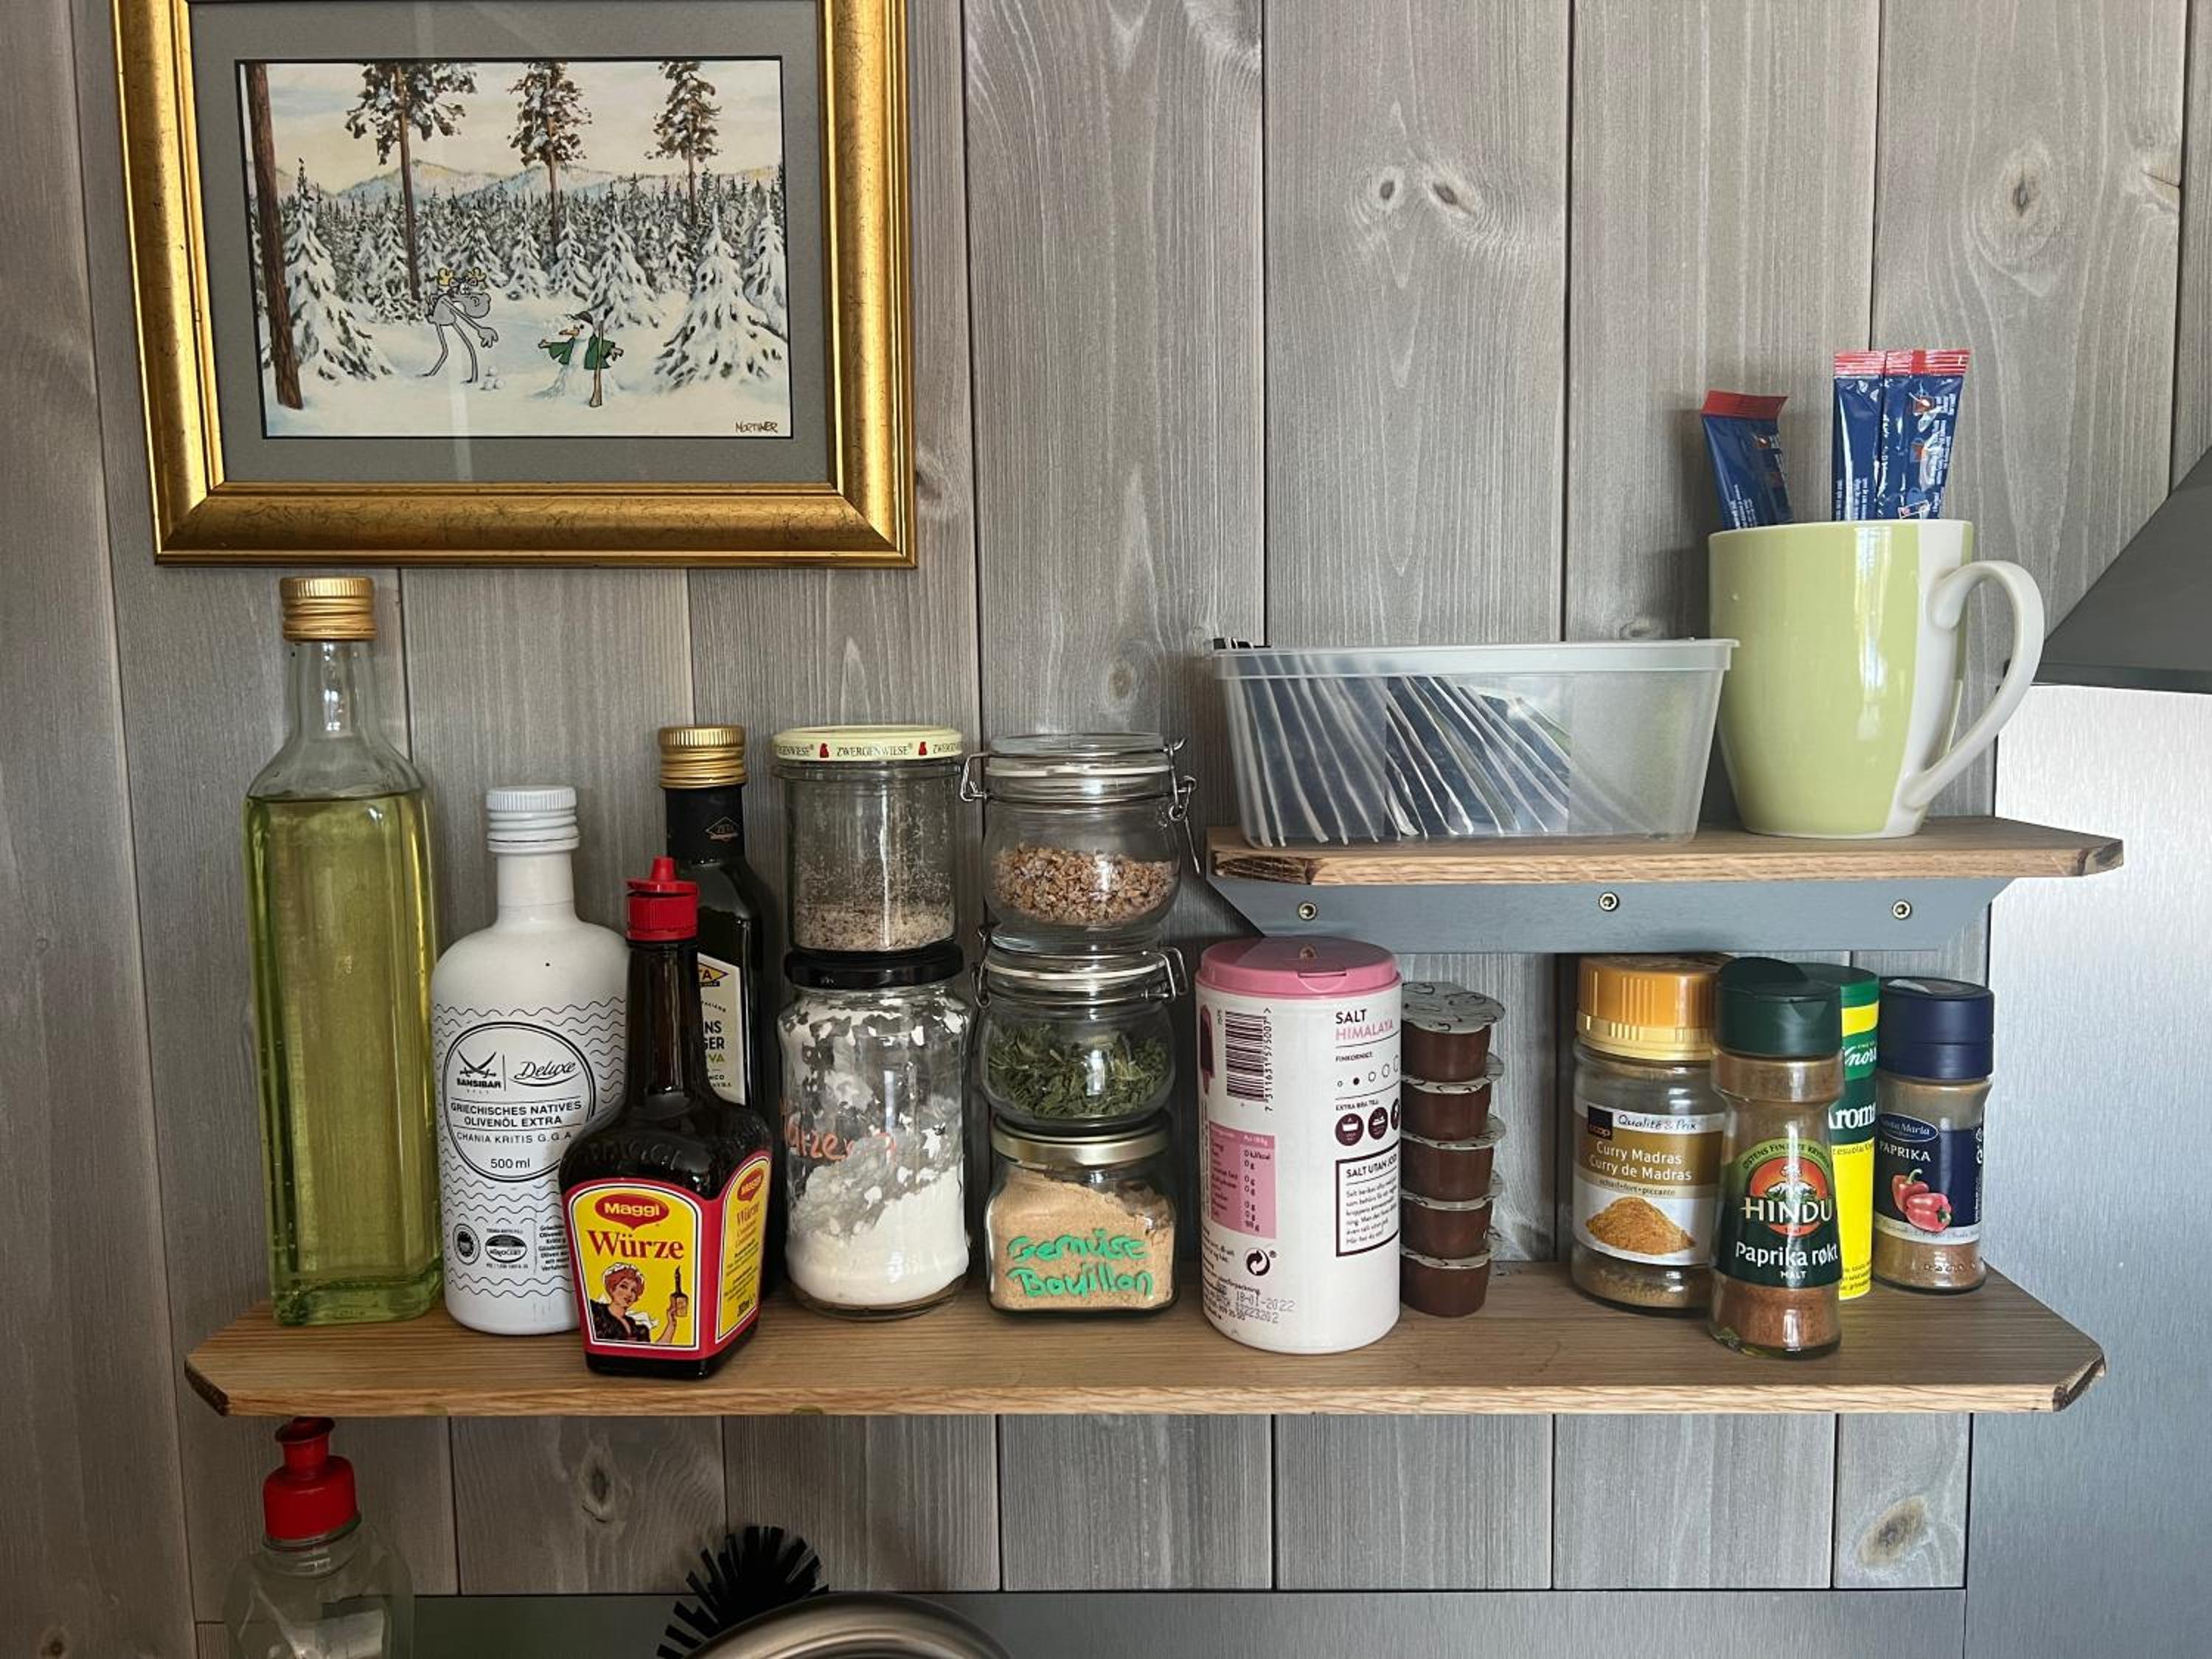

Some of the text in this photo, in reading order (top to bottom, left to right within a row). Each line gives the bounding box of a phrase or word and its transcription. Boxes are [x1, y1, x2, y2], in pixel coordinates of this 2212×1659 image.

[1335, 1009, 1367, 1024] SALT
[1335, 1018, 1393, 1040] HIMALAYA
[514, 1060, 577, 1080] Deluxe
[456, 1078, 502, 1089] SANSIBAR
[451, 1101, 582, 1116] GRIECHISCHES NATIVES
[464, 1116, 563, 1127] OLIVENÖL EXTRA
[1676, 1119, 1697, 1130] Prix
[1900, 1122, 1930, 1135] Maria
[456, 1130, 491, 1144] CHANIA
[495, 1134, 533, 1144] KRITIS
[1596, 1141, 1683, 1165] Curry Madras
[1879, 1141, 1931, 1162] PAPRIKA
[490, 1158, 531, 1169] 500 ml
[1589, 1155, 1692, 1181] Curry de Madras
[1346, 1166, 1367, 1178] SALT
[604, 1202, 660, 1217] Maggi
[1740, 1197, 1833, 1223] HINDU
[586, 1228, 686, 1260] Würze
[1736, 1242, 1838, 1267] Paprika røkt
[1006, 1262, 1155, 1300] Bouillon
[1780, 1270, 1807, 1279] MALT
